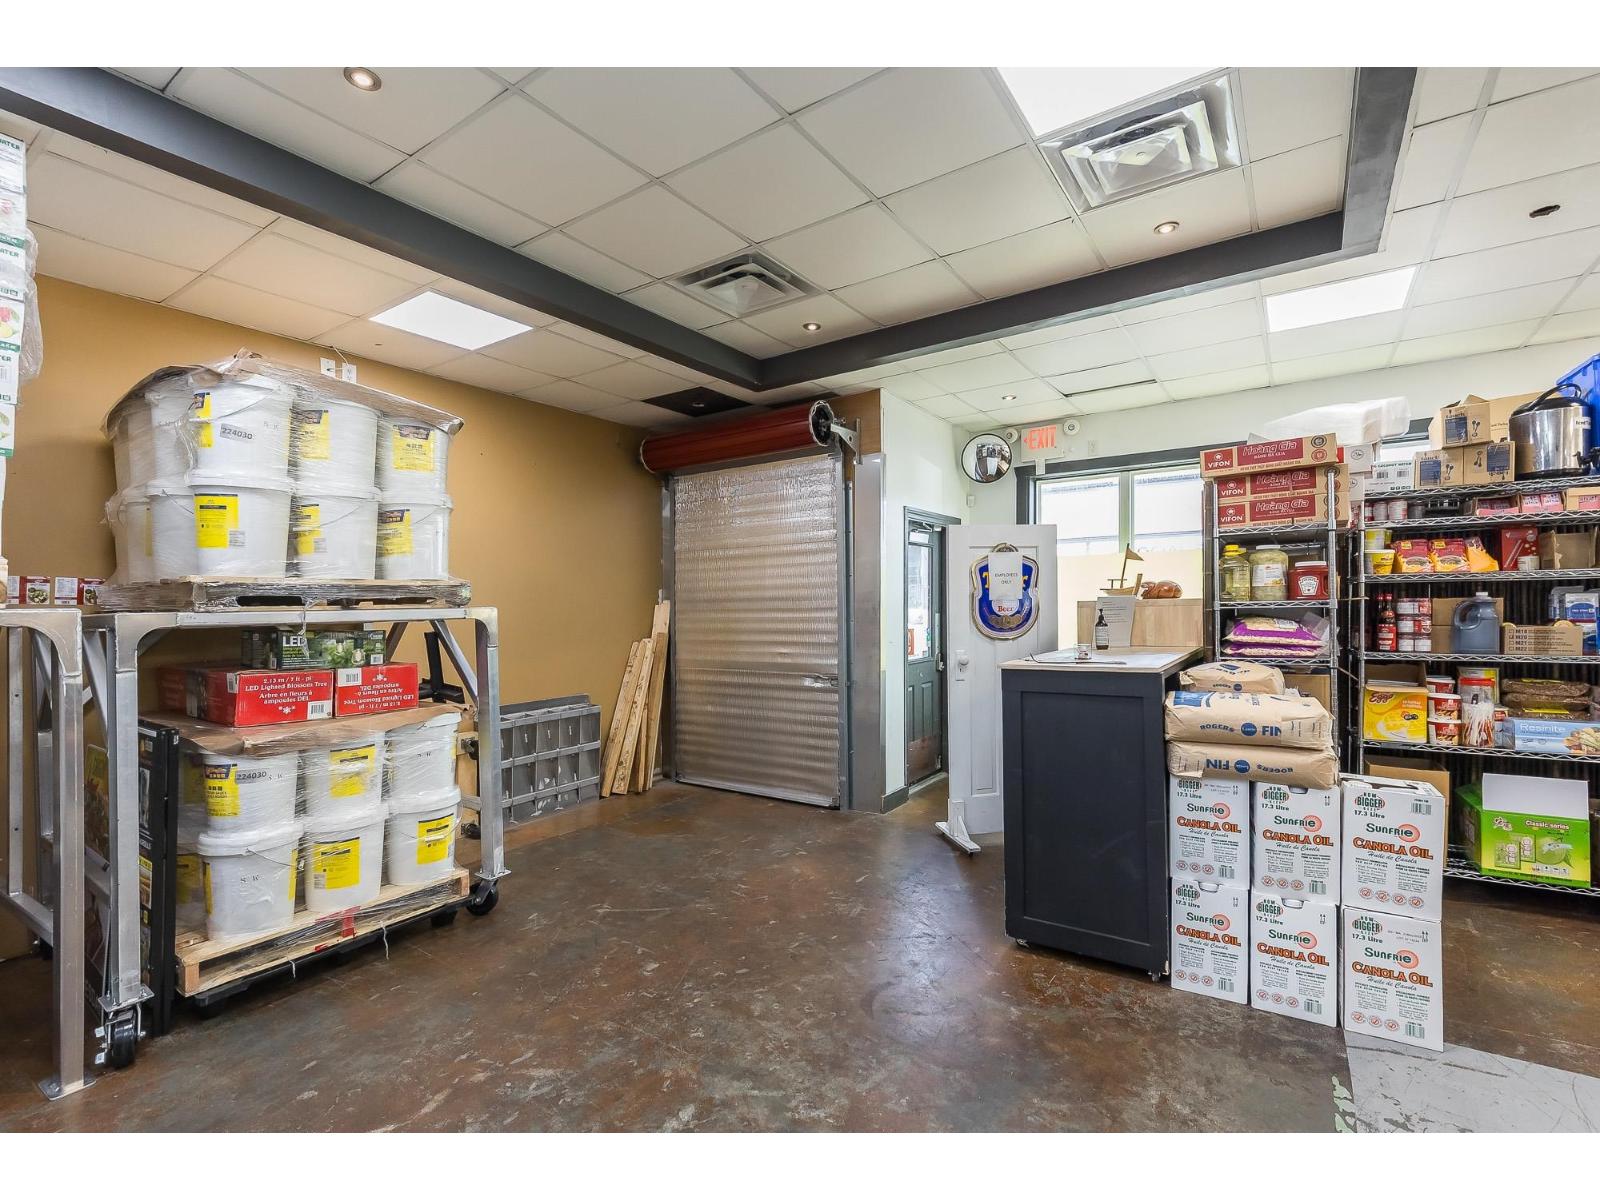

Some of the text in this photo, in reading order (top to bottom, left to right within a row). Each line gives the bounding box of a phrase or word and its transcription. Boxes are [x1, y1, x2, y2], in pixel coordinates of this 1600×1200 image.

[221, 427, 253, 440] 224030
[1027, 424, 1057, 449] EXIT
[1278, 440, 1297, 451] Gia
[1207, 460, 1231, 468] VIFON
[1221, 488, 1244, 496] VIFON
[282, 635, 306, 647] LED
[245, 684, 260, 692] LED
[1369, 691, 1394, 703] Eggo
[1199, 723, 1235, 733] ROGERS
[1519, 722, 1566, 733] Resinite
[1205, 759, 1230, 771] FIN
[1256, 763, 1294, 774] ROGERS
[1263, 790, 1287, 801] BIGGER
[1357, 796, 1383, 808] BIGGER
[1369, 811, 1385, 819] Litre
[1177, 816, 1241, 833] CANOLA OIL
[1525, 819, 1549, 828] Classic
[1263, 829, 1334, 847] CANOLA OIL
[1353, 836, 1434, 860] CANOLA OIL
[1259, 902, 1281, 915] BIGGER
[1269, 917, 1284, 925] Litre
[1354, 919, 1380, 933] BIGGER
[1176, 924, 1241, 947] CANOLA OIL
[1367, 935, 1383, 944] Litre
[1256, 942, 1330, 967] CANOLA OIL
[1351, 960, 1434, 988] CANOLA OIL
